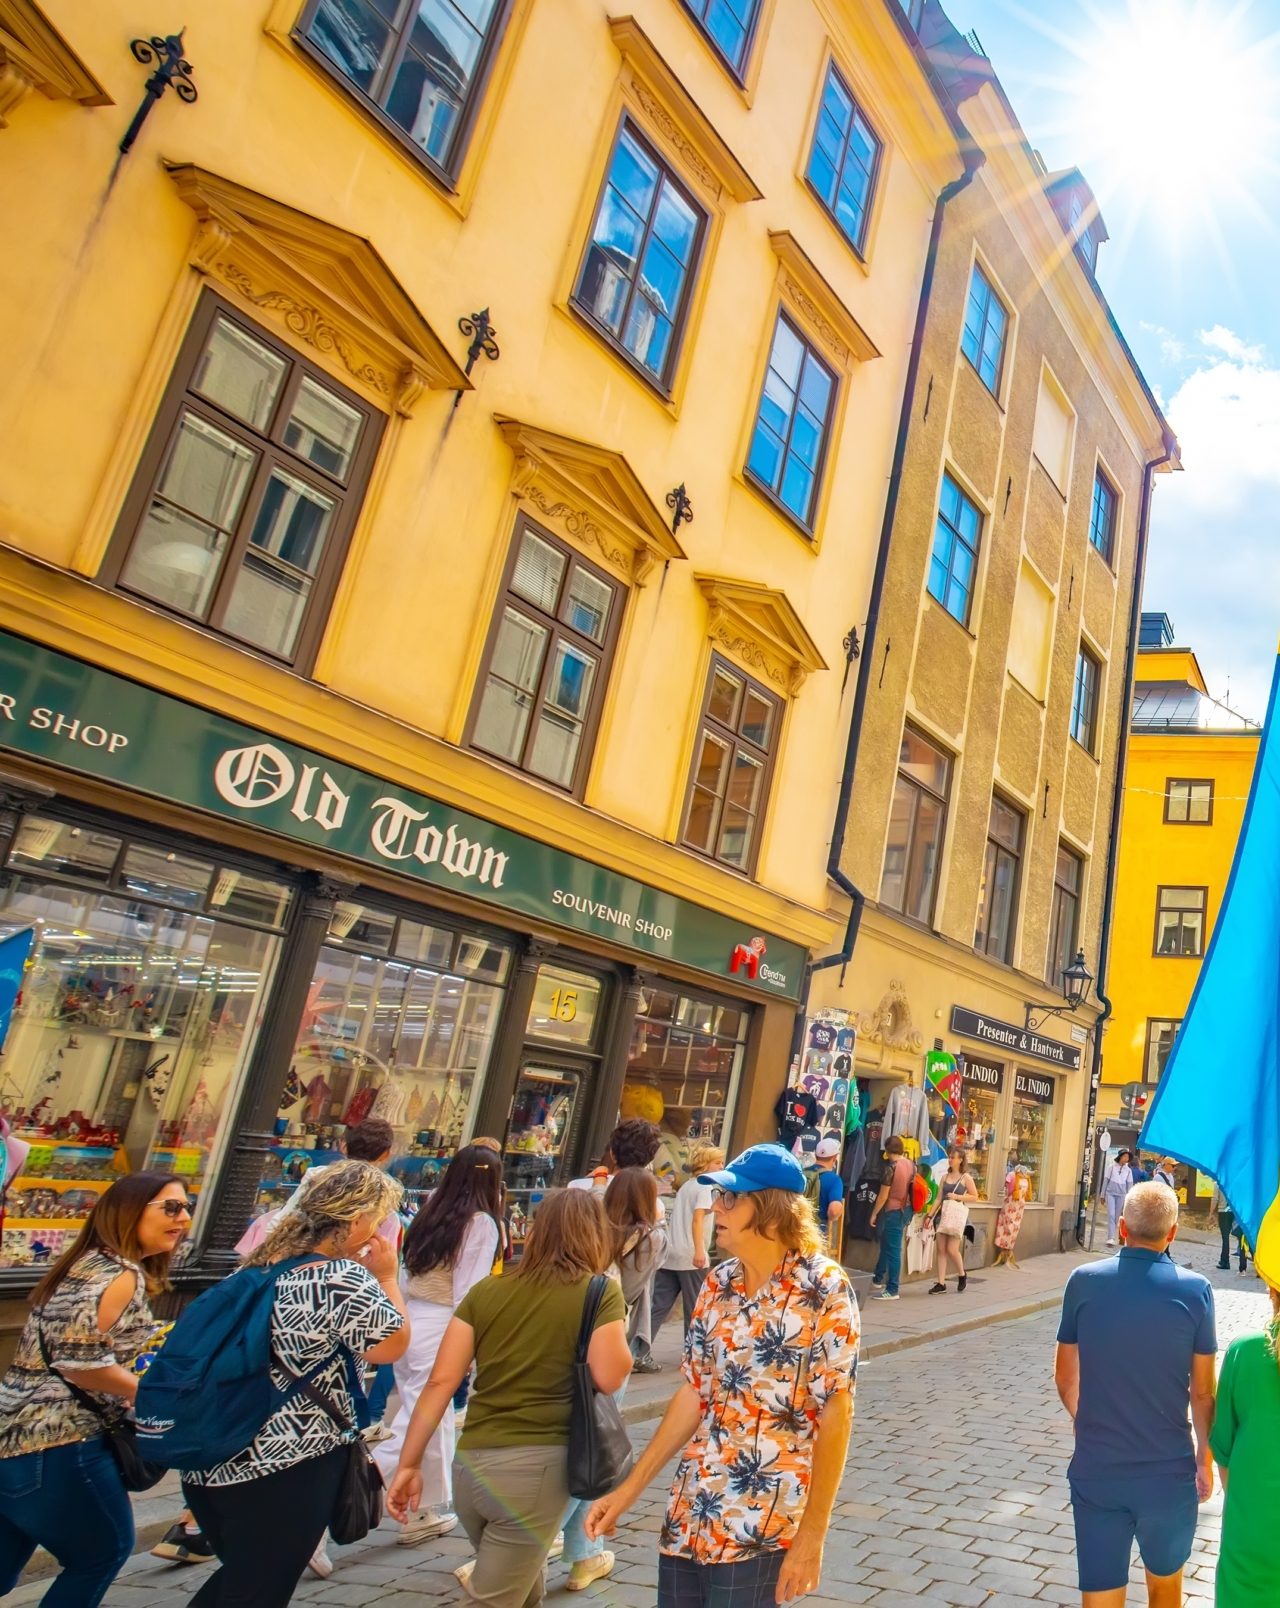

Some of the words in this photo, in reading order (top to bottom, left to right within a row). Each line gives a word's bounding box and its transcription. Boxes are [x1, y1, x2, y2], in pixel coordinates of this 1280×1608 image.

[29, 707, 129, 753] SHOP
[214, 743, 351, 831] Old
[371, 797, 509, 888] Town
[552, 889, 631, 928] SOUVENIR
[635, 918, 673, 941] SHOP
[550, 988, 578, 1024] 15
[976, 1019, 1017, 1046] Presenter
[1020, 1034, 1027, 1049] &
[1031, 1037, 1064, 1061] Hantverk
[971, 1064, 999, 1085] INDIO
[1016, 1075, 1027, 1092] EL
[1028, 1080, 1051, 1097] INDIO
